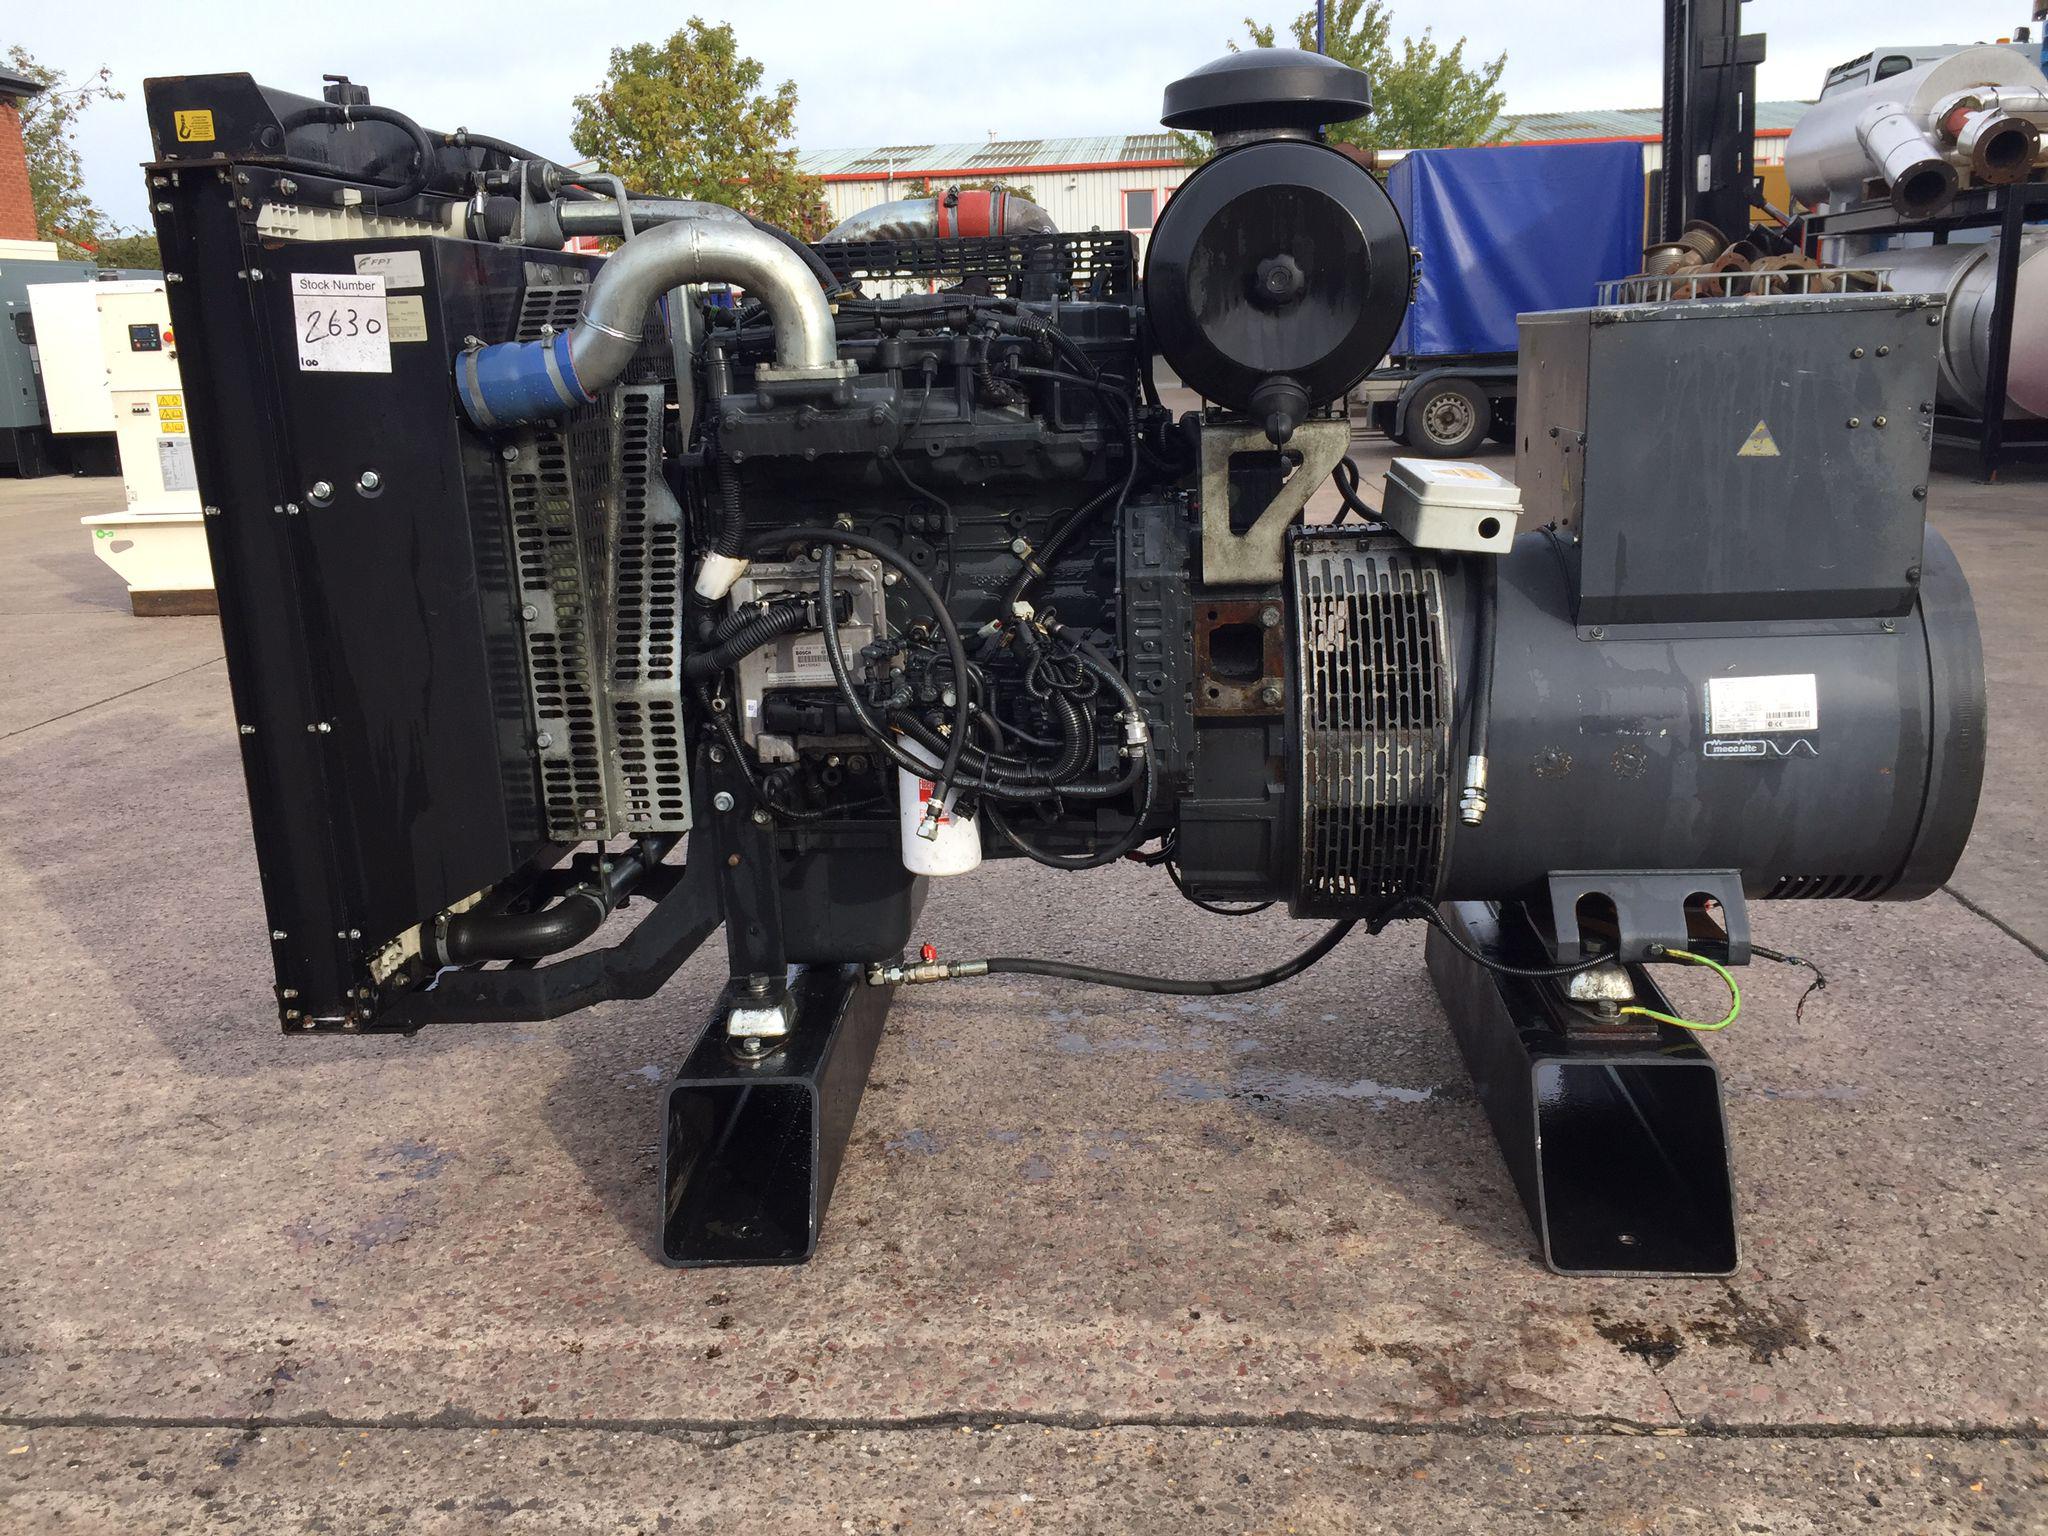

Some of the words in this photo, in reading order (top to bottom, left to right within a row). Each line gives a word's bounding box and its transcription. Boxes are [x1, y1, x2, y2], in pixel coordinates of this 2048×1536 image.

[300, 279, 330, 290] Stock
[333, 280, 376, 291] Number
[305, 309, 381, 343] 2630
